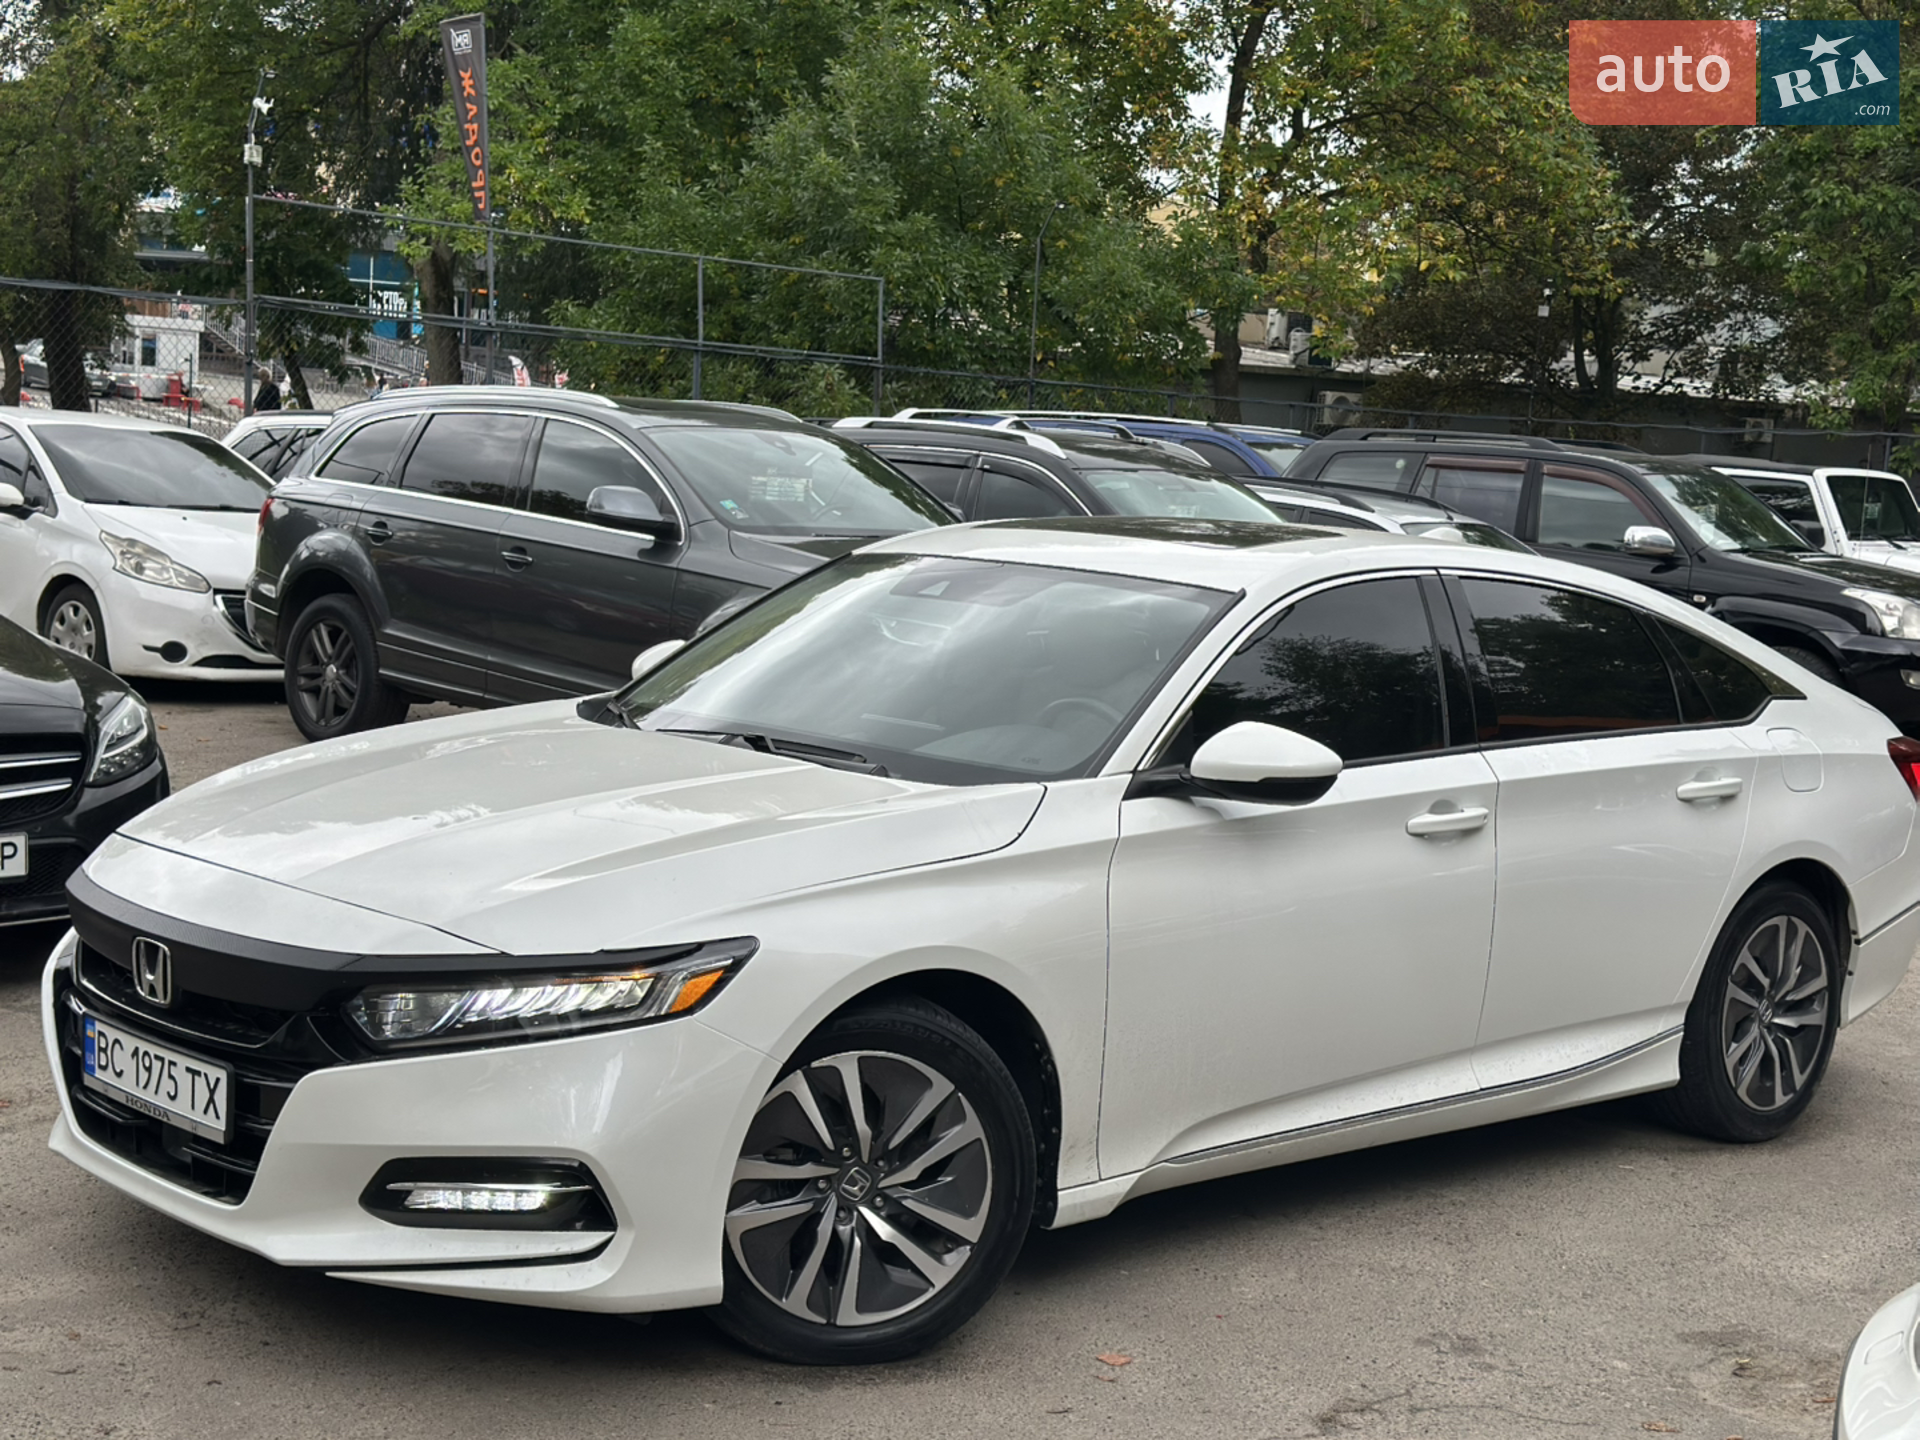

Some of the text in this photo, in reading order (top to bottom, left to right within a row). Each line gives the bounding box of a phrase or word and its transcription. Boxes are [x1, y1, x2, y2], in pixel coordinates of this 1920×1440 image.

[1, 841, 18, 871] P
[97, 1030, 221, 1120] BC 1975 TX
[124, 1094, 172, 1122] HONDA
